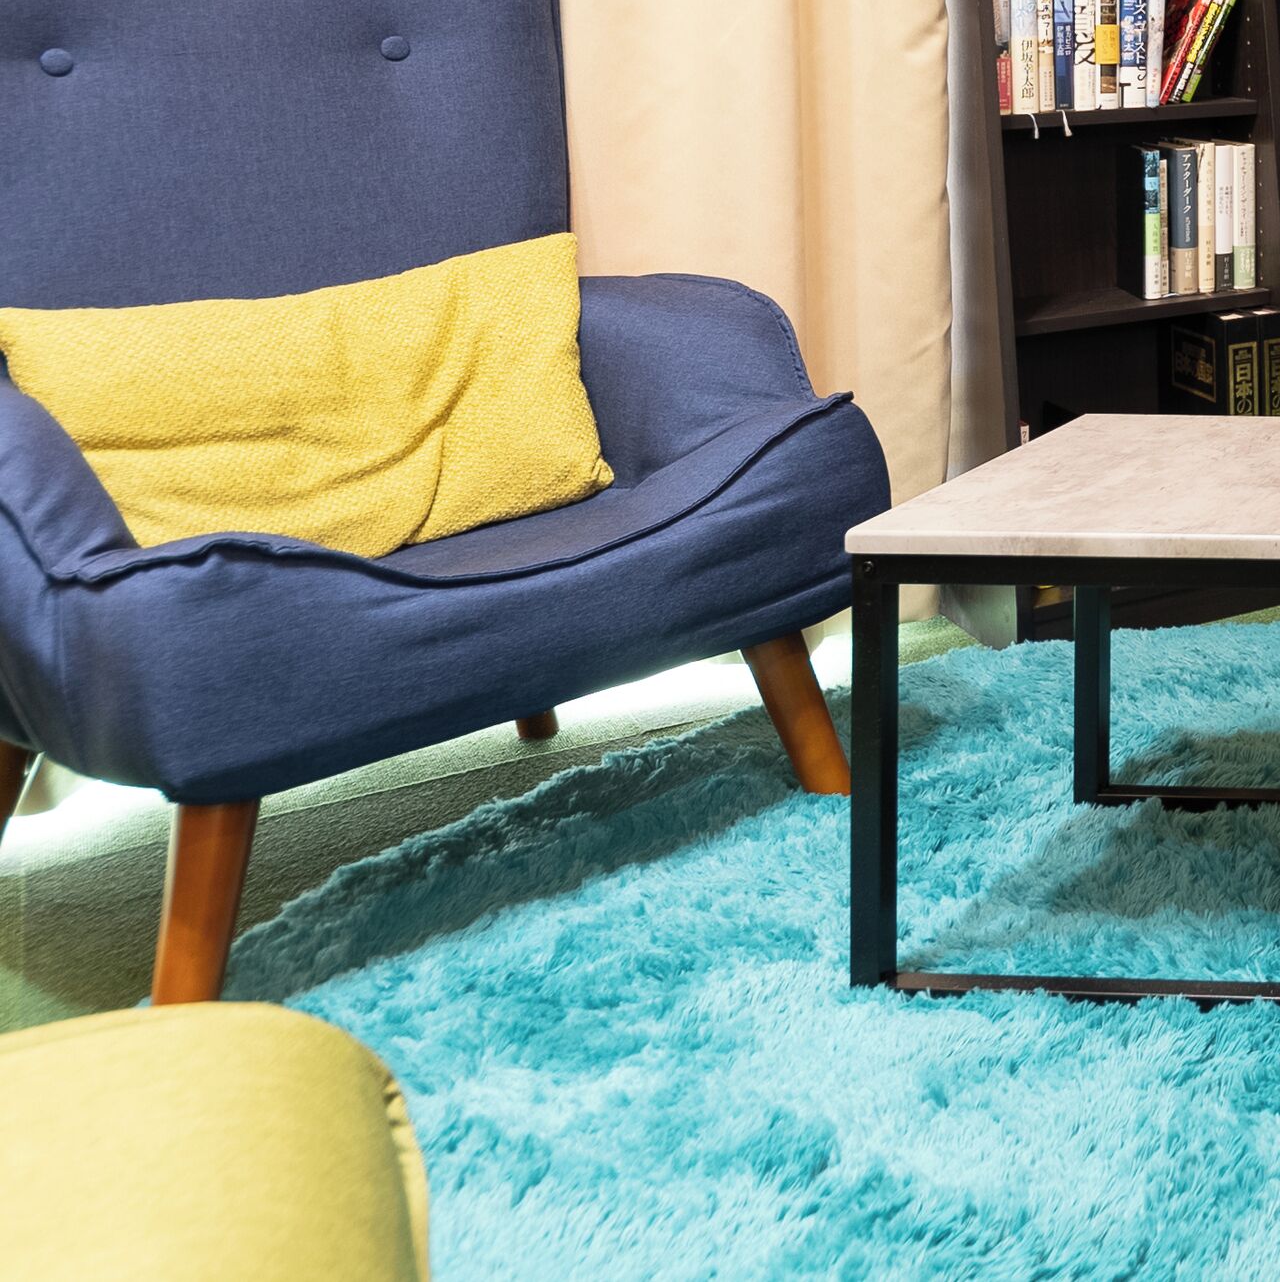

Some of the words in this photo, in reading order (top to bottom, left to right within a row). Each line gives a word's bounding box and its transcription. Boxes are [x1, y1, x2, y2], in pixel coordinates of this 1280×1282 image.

[1021, 39, 1035, 99] 伊坂幸太郎
[1056, 24, 1064, 56] 伊坂幸太郎
[1182, 153, 1193, 215] アフターダーク
